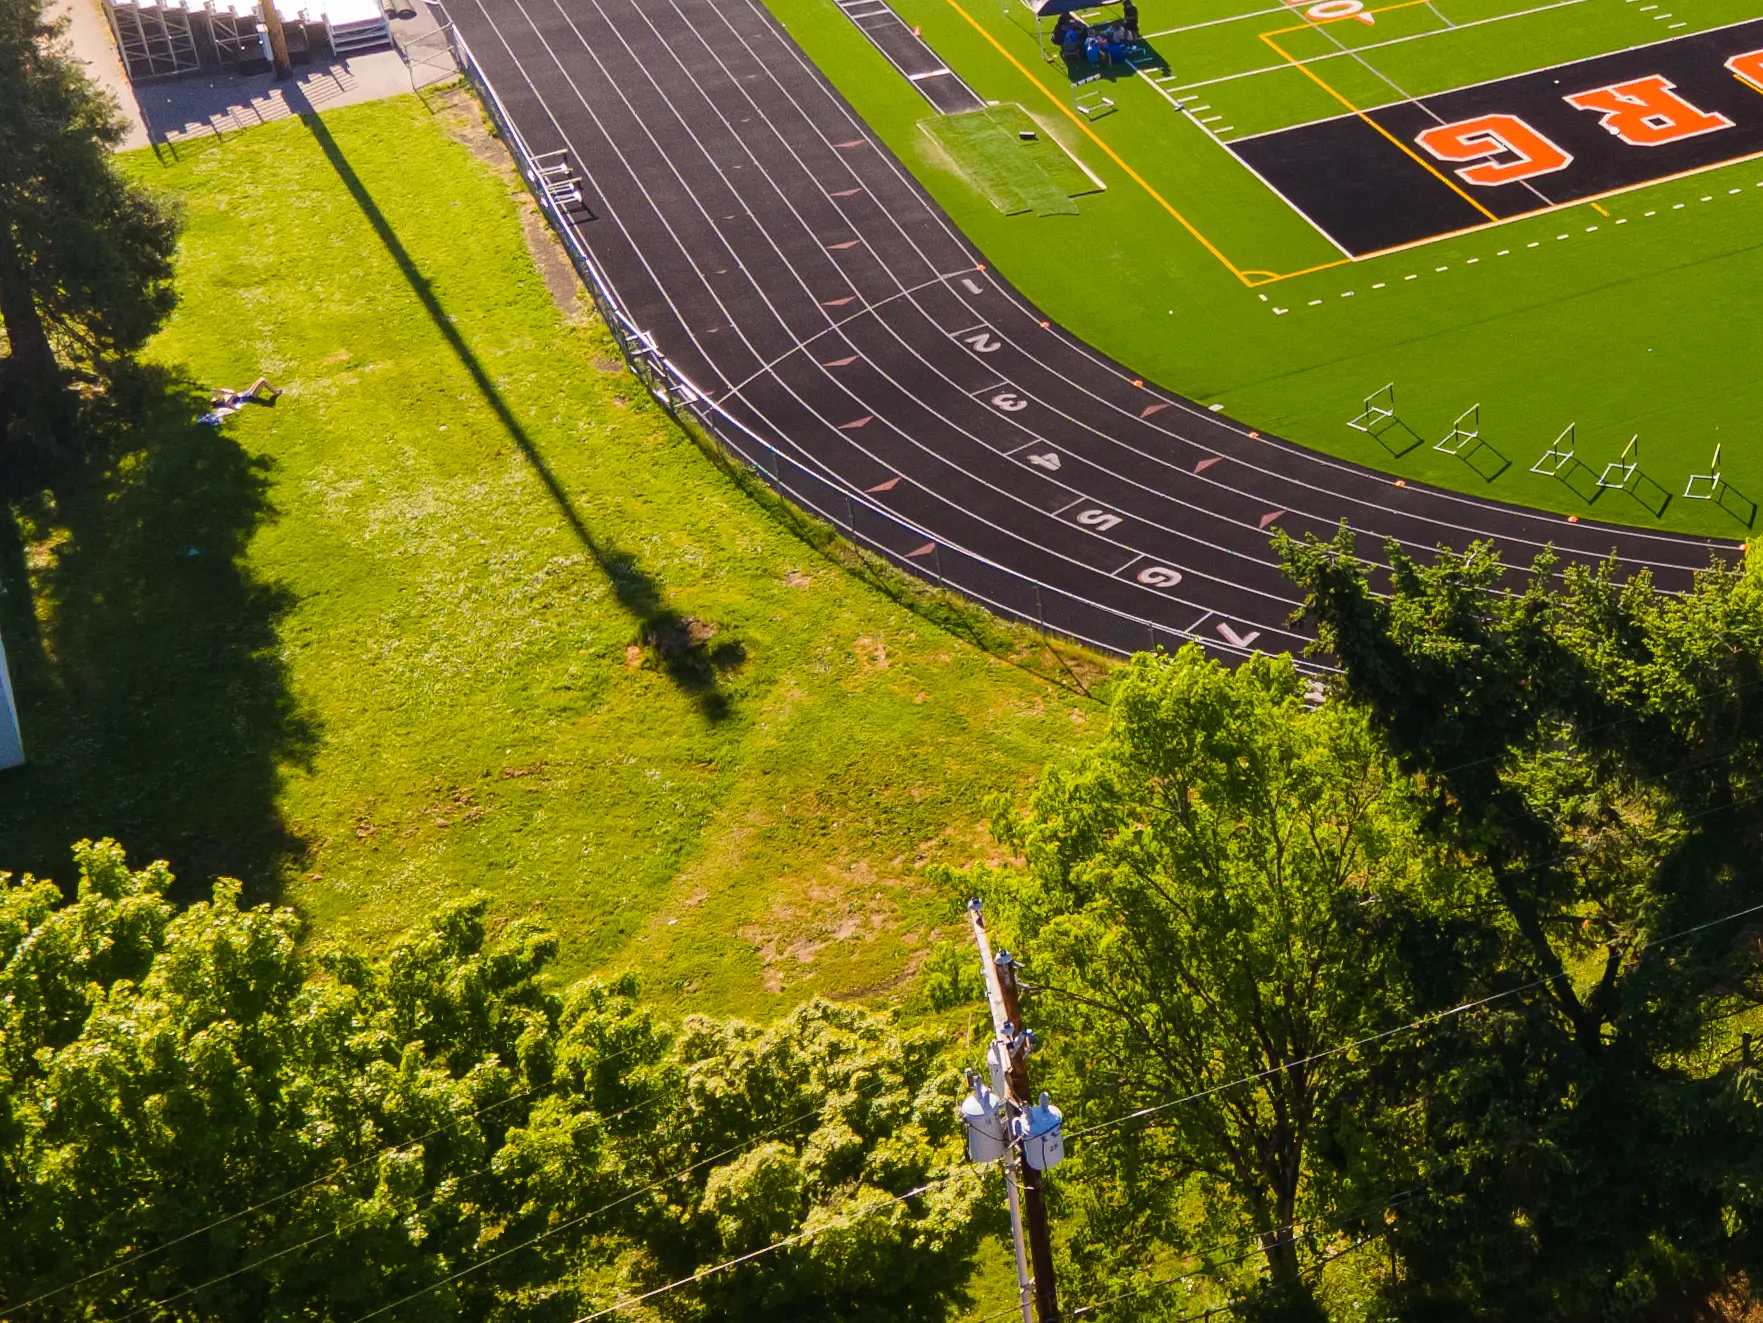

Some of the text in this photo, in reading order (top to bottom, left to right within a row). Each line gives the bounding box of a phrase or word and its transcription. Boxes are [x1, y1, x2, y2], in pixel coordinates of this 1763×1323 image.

[961, 278, 984, 295] 1
[964, 333, 1001, 354] 2
[991, 393, 1028, 412] 3
[1026, 452, 1062, 472] 4
[1076, 509, 1124, 531] 5
[1137, 565, 1183, 588] 6
[1215, 622, 1261, 648] 7
